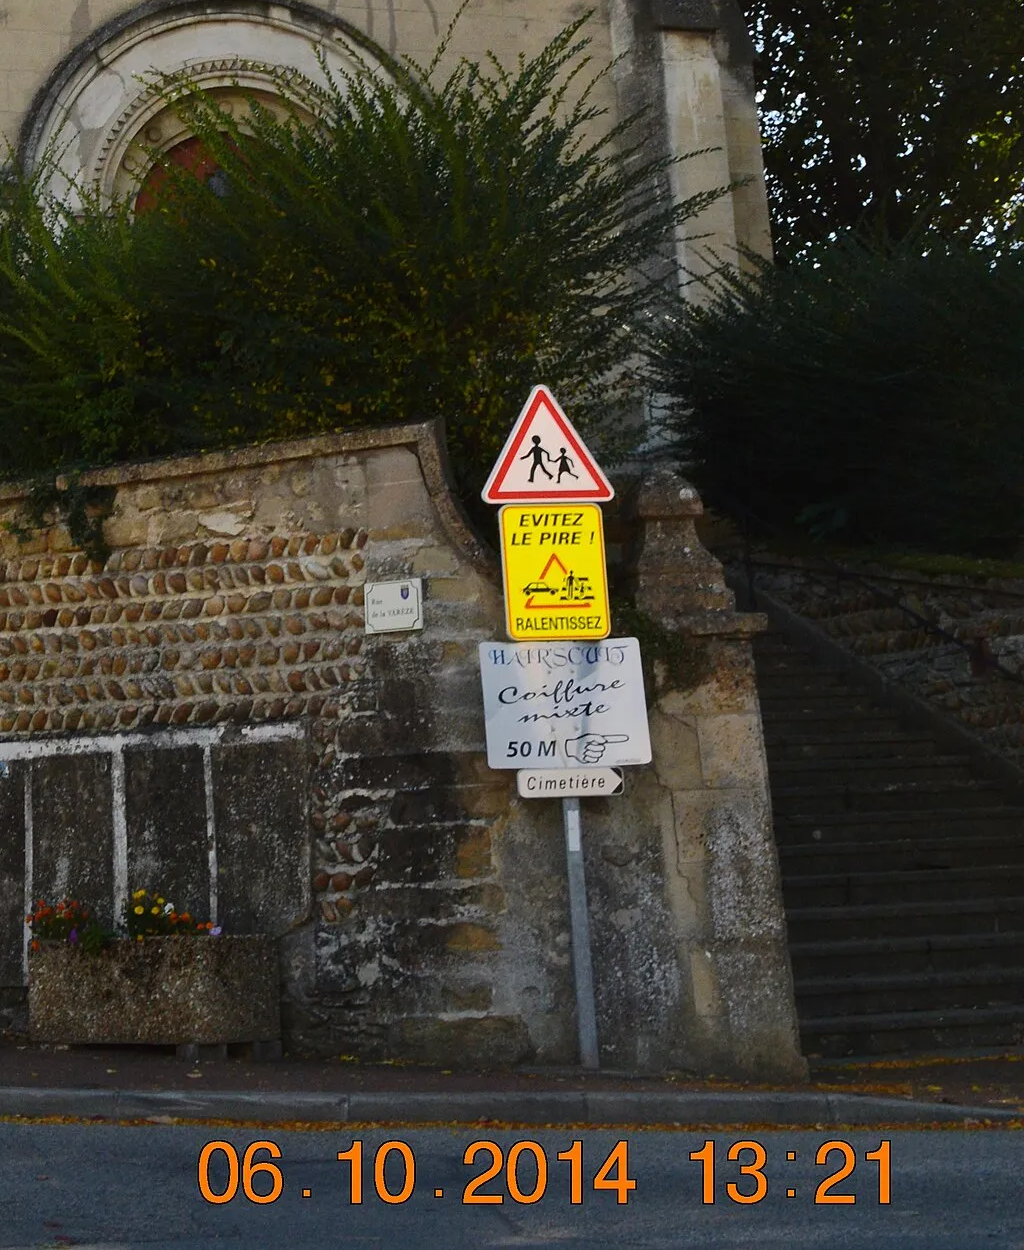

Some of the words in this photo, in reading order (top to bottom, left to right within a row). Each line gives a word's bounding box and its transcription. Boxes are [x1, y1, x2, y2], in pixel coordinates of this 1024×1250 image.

[519, 513, 584, 527] EVITEZ
[511, 532, 533, 546] LE
[539, 531, 582, 545] PIRE
[589, 531, 595, 545] !
[516, 616, 603, 631] RALENTISSEZ
[498, 678, 626, 705] Coiffure
[517, 701, 610, 723] mixte
[506, 741, 532, 758] 50
[537, 740, 557, 757] M
[527, 774, 606, 791] Cimetière
